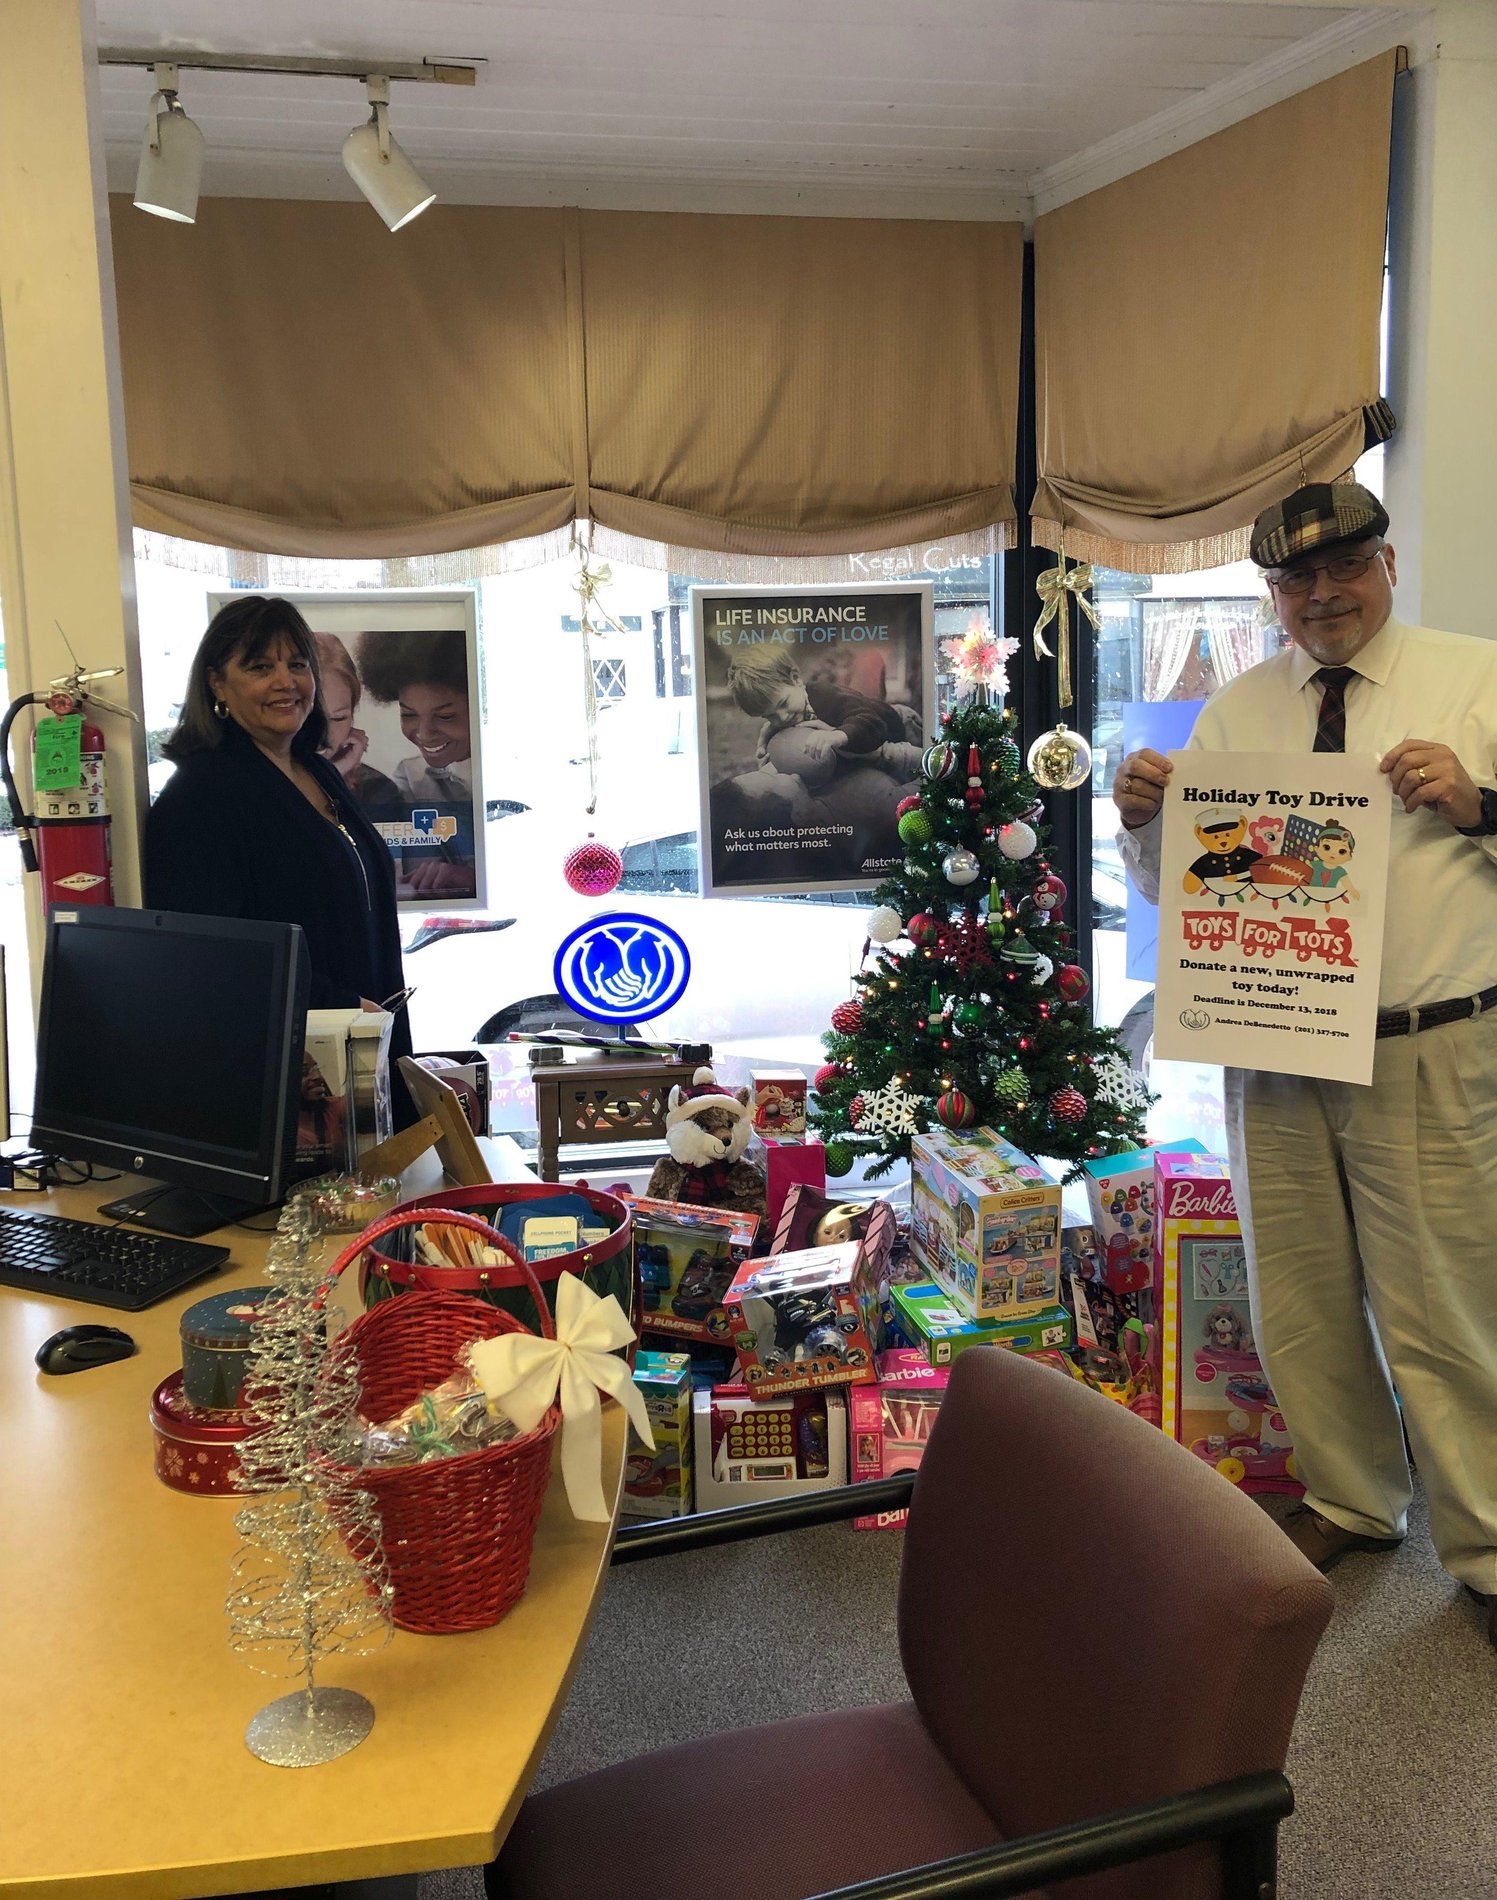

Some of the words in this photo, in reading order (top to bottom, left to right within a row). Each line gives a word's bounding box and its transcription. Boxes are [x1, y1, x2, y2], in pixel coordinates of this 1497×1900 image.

[923, 547, 982, 572] Cuts
[715, 608, 752, 626] LIFE
[757, 606, 867, 625] INSURANCE
[716, 630, 732, 646] IS
[737, 629, 765, 645] AN
[770, 627, 807, 644] ACT
[811, 627, 837, 643] OF
[841, 625, 888, 642] LOVE
[1182, 787, 1261, 808] Holiday
[1265, 790, 1303, 808] Toy
[1309, 791, 1369, 808] Drive
[409, 836, 441, 845] FAMILY
[724, 828, 745, 840] Ask
[748, 830, 761, 839] us
[762, 826, 795, 839] about
[797, 824, 854, 841] protecting
[725, 841, 753, 853] what
[756, 839, 799, 852] matters
[801, 838, 832, 850] most.
[1186, 915, 1234, 938] TOYS
[1243, 924, 1282, 946] FOR
[1293, 930, 1345, 955] TOTS
[1179, 959, 1227, 972] Donate
[1229, 965, 1237, 973] a
[1240, 966, 1272, 977] new,
[1276, 968, 1355, 983] unwrapped
[1232, 980, 1254, 992] toy
[1257, 983, 1299, 996] today!
[1193, 995, 1235, 1006] Deadline
[1237, 998, 1245, 1006] is
[1247, 1000, 1296, 1012] December
[1314, 1007, 1338, 1016] 2018
[1215, 1017, 1242, 1026] Andrea
[1244, 1020, 1291, 1031] DeBenedetto
[1294, 1025, 1315, 1035] (201)
[1168, 1181, 1238, 1217] Barbie
[653, 1317, 704, 1332] BUMPERS
[756, 1378, 810, 1395] THUNDER
[812, 1369, 868, 1385] TUMBLER
